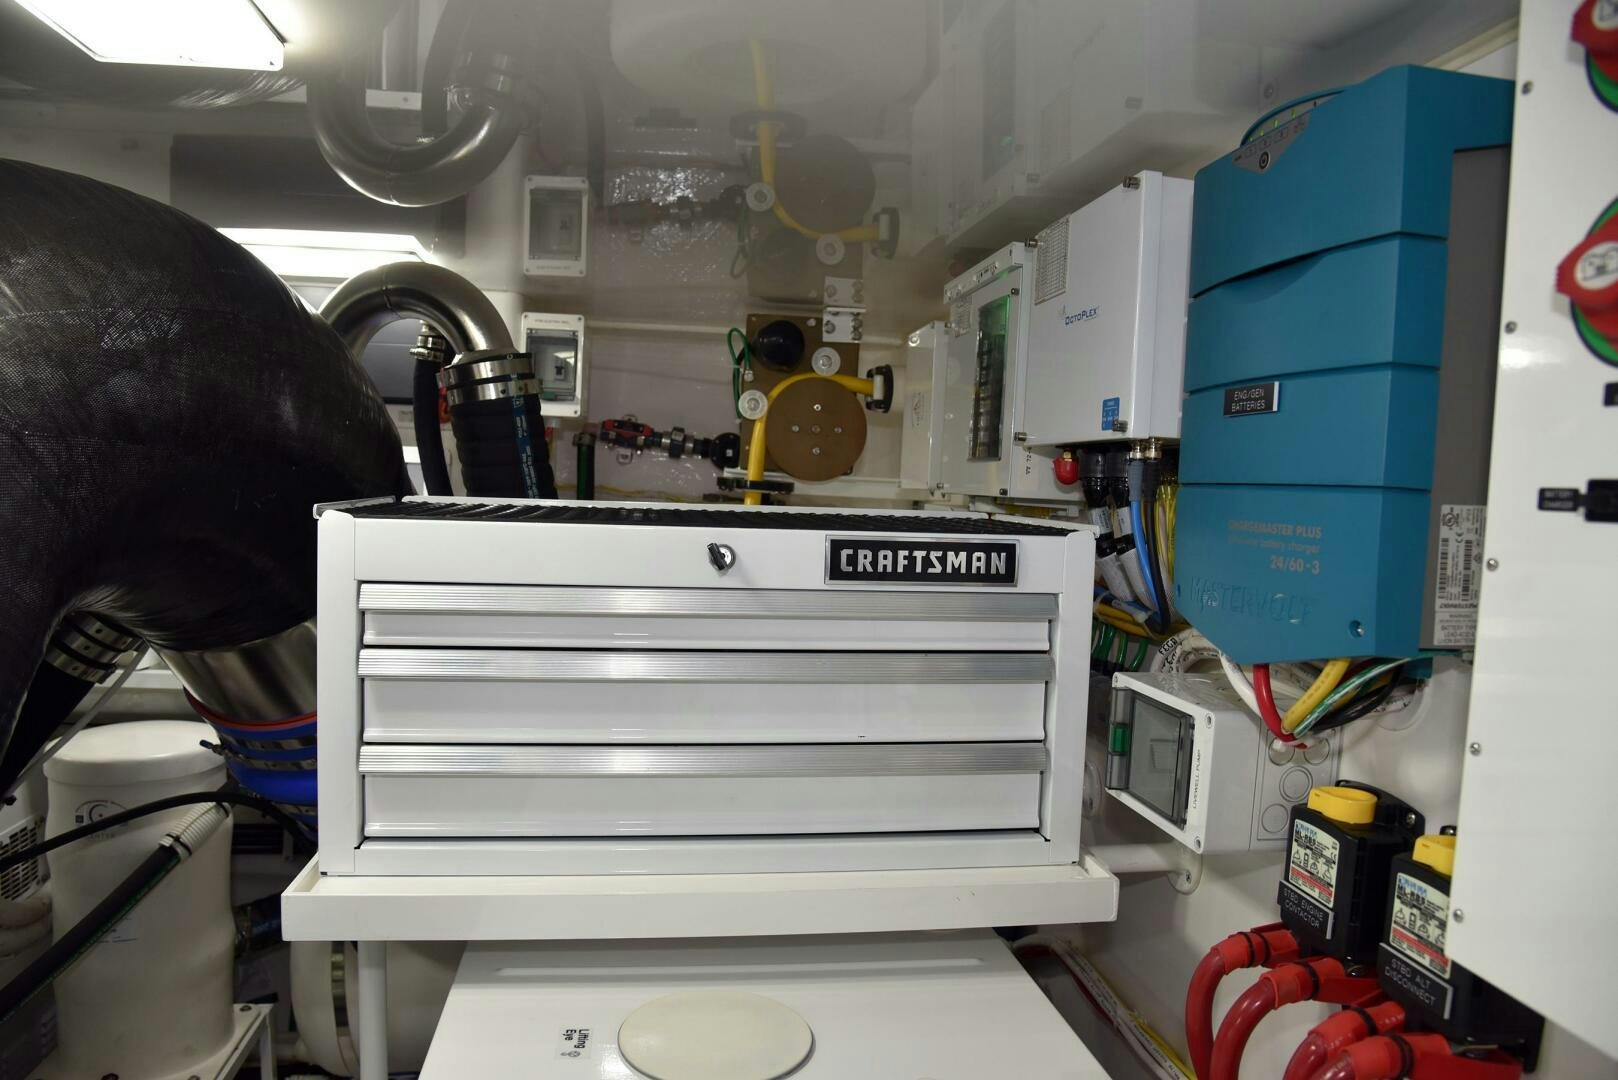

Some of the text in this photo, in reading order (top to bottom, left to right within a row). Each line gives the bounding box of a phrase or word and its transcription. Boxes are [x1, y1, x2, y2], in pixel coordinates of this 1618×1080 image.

[1233, 388, 1265, 400] ENG/GEN
[1231, 400, 1266, 412] BATTERIES
[1295, 526, 1322, 539] PLUS
[840, 548, 1007, 574] CRAFTSMAN
[1269, 555, 1320, 575] 24/60-3
[1284, 898, 1321, 929] CONTACTOR
[1301, 900, 1325, 922] ENGINE
[1384, 965, 1437, 1006] DISCONNECT
[562, 1029, 578, 1041] Eye
[573, 1028, 591, 1049] Lifting
